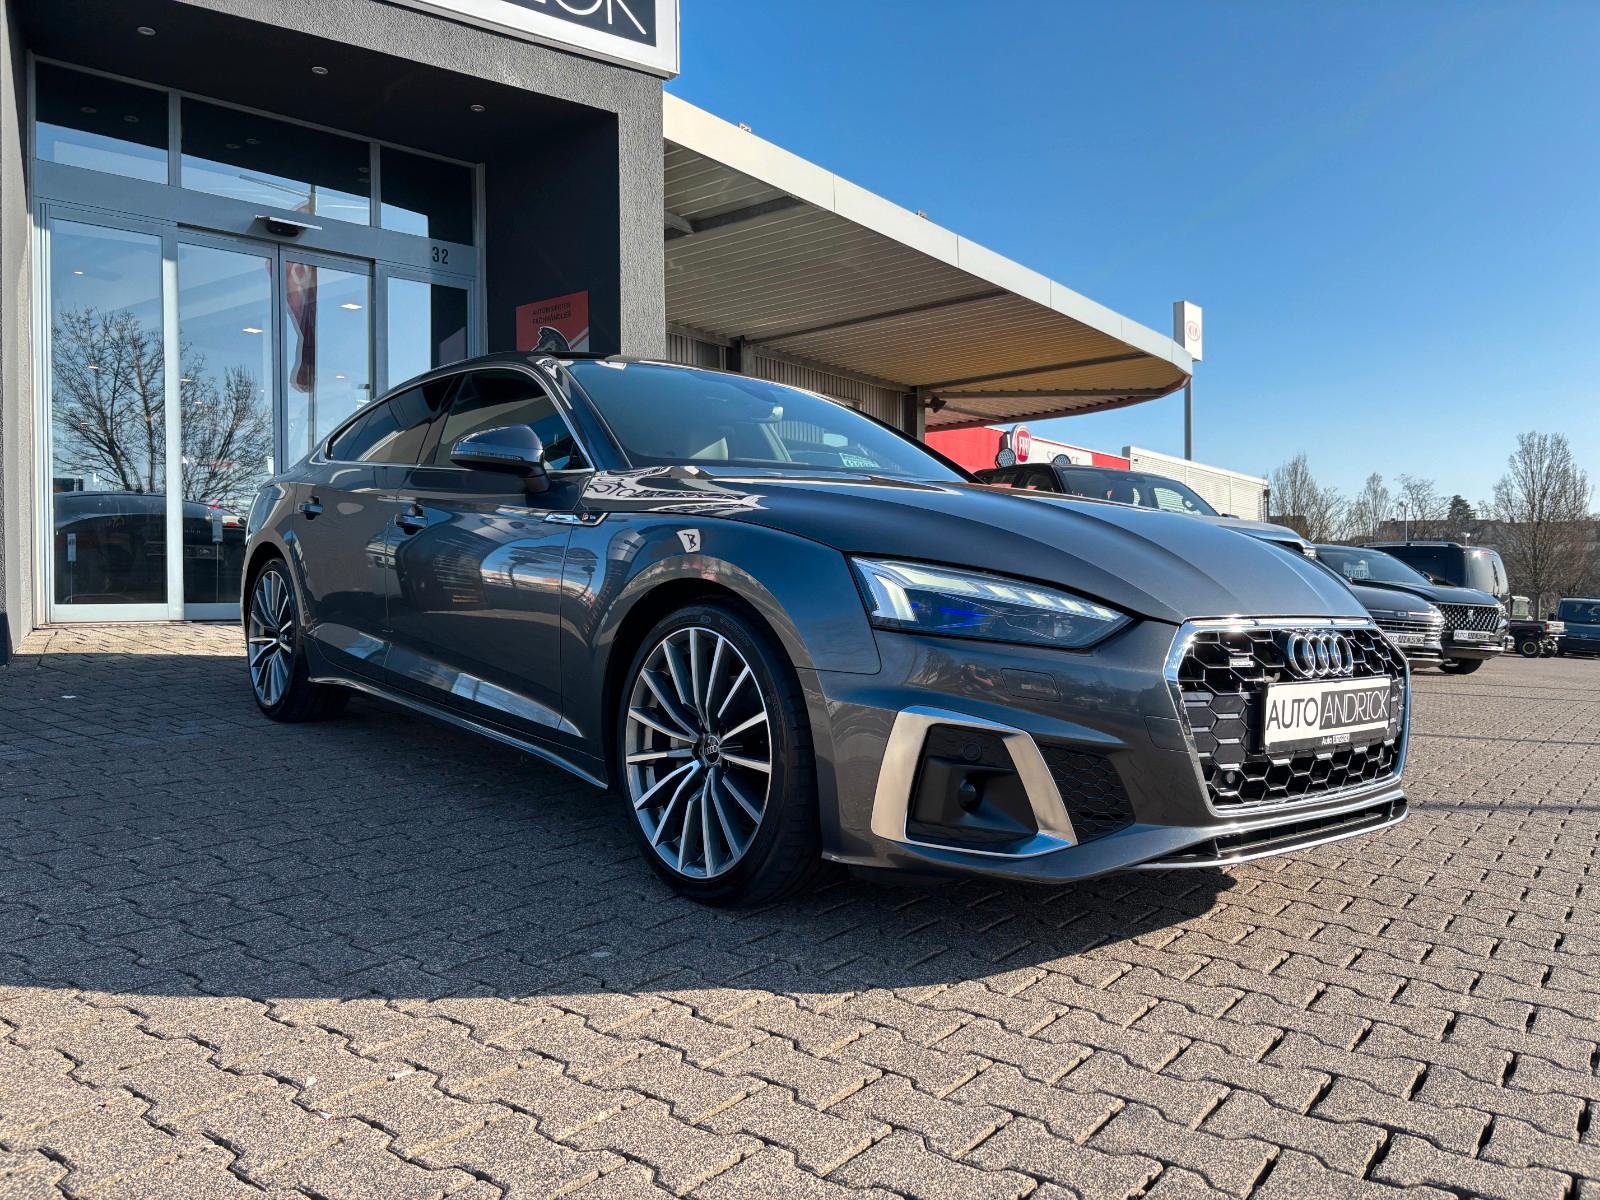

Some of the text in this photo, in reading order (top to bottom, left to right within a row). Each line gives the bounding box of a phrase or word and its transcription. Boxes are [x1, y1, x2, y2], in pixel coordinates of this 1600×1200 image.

[432, 246, 449, 265] 32
[1046, 450, 1080, 465] SECE
[1265, 689, 1390, 730] AUTO ANDRICK
